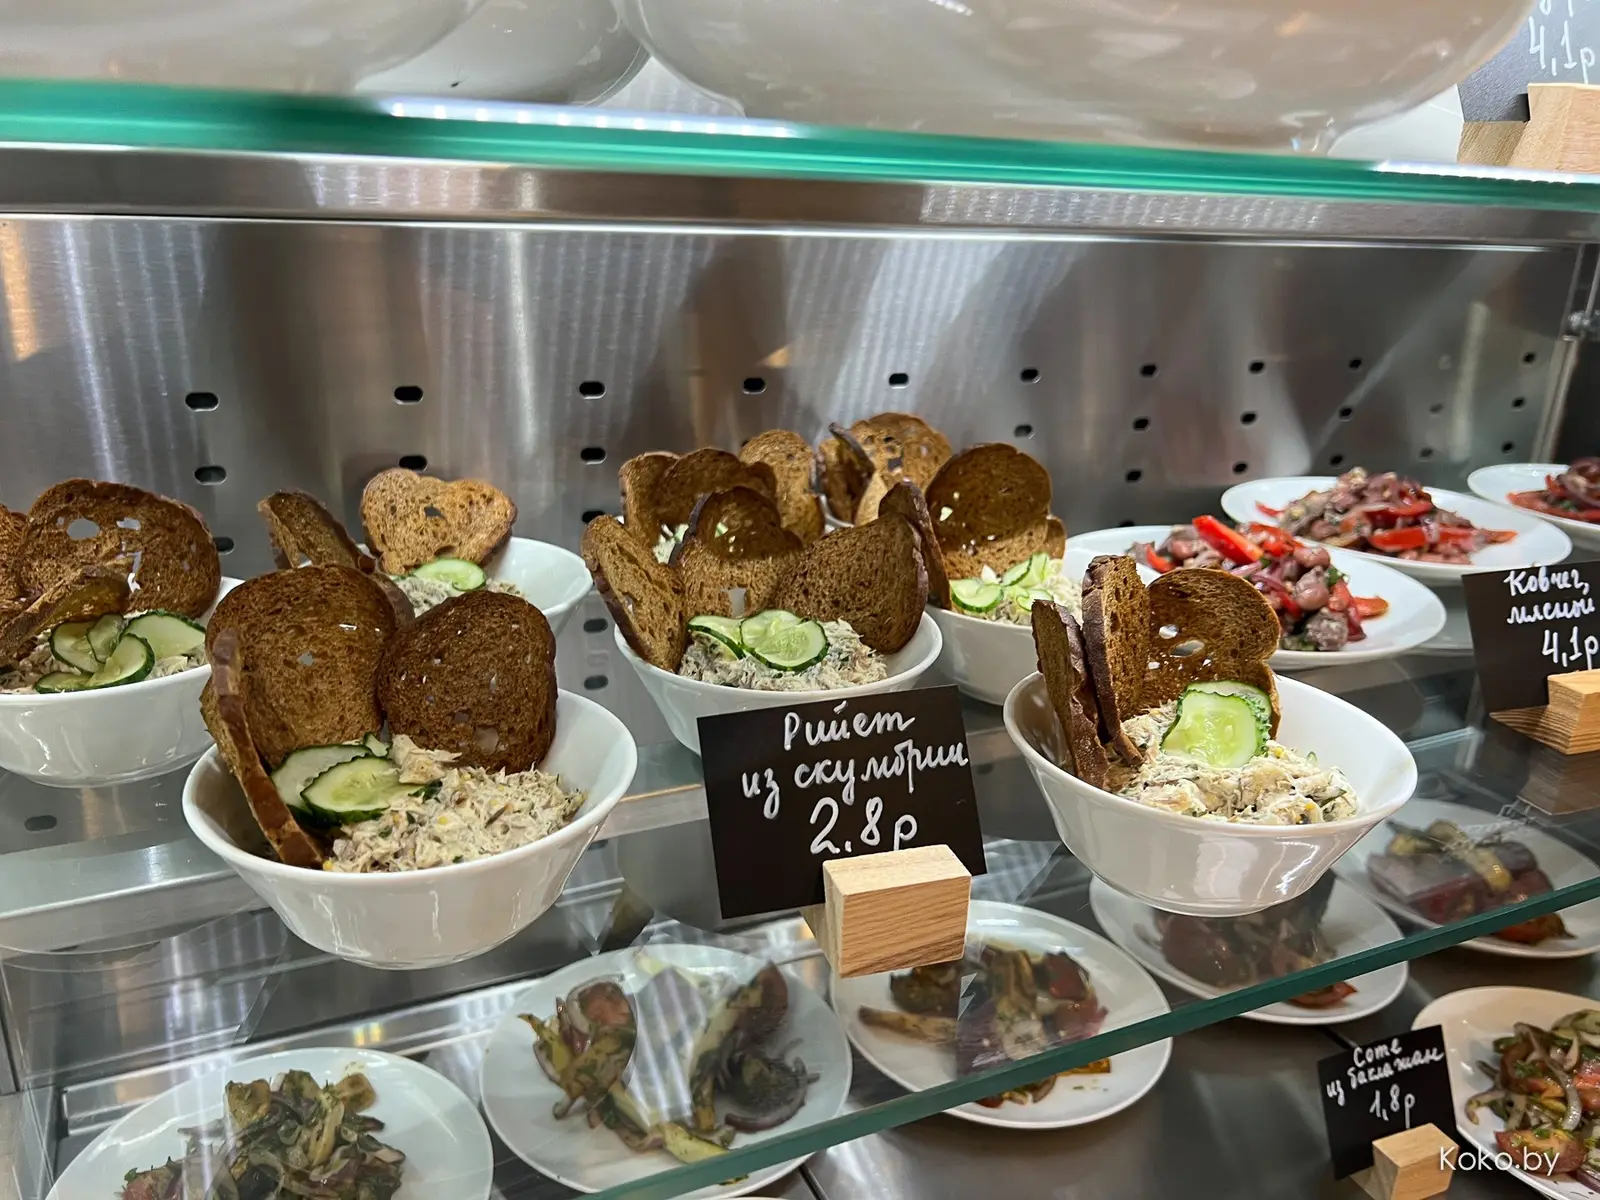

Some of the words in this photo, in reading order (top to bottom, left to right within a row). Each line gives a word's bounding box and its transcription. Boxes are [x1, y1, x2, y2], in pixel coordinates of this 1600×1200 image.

[1541, 626, 1599, 670] 4,1р
[783, 700, 916, 751] Рийет
[741, 767, 781, 819] из
[1353, 1038, 1402, 1068] Соте
[1326, 1079, 1345, 1106] из
